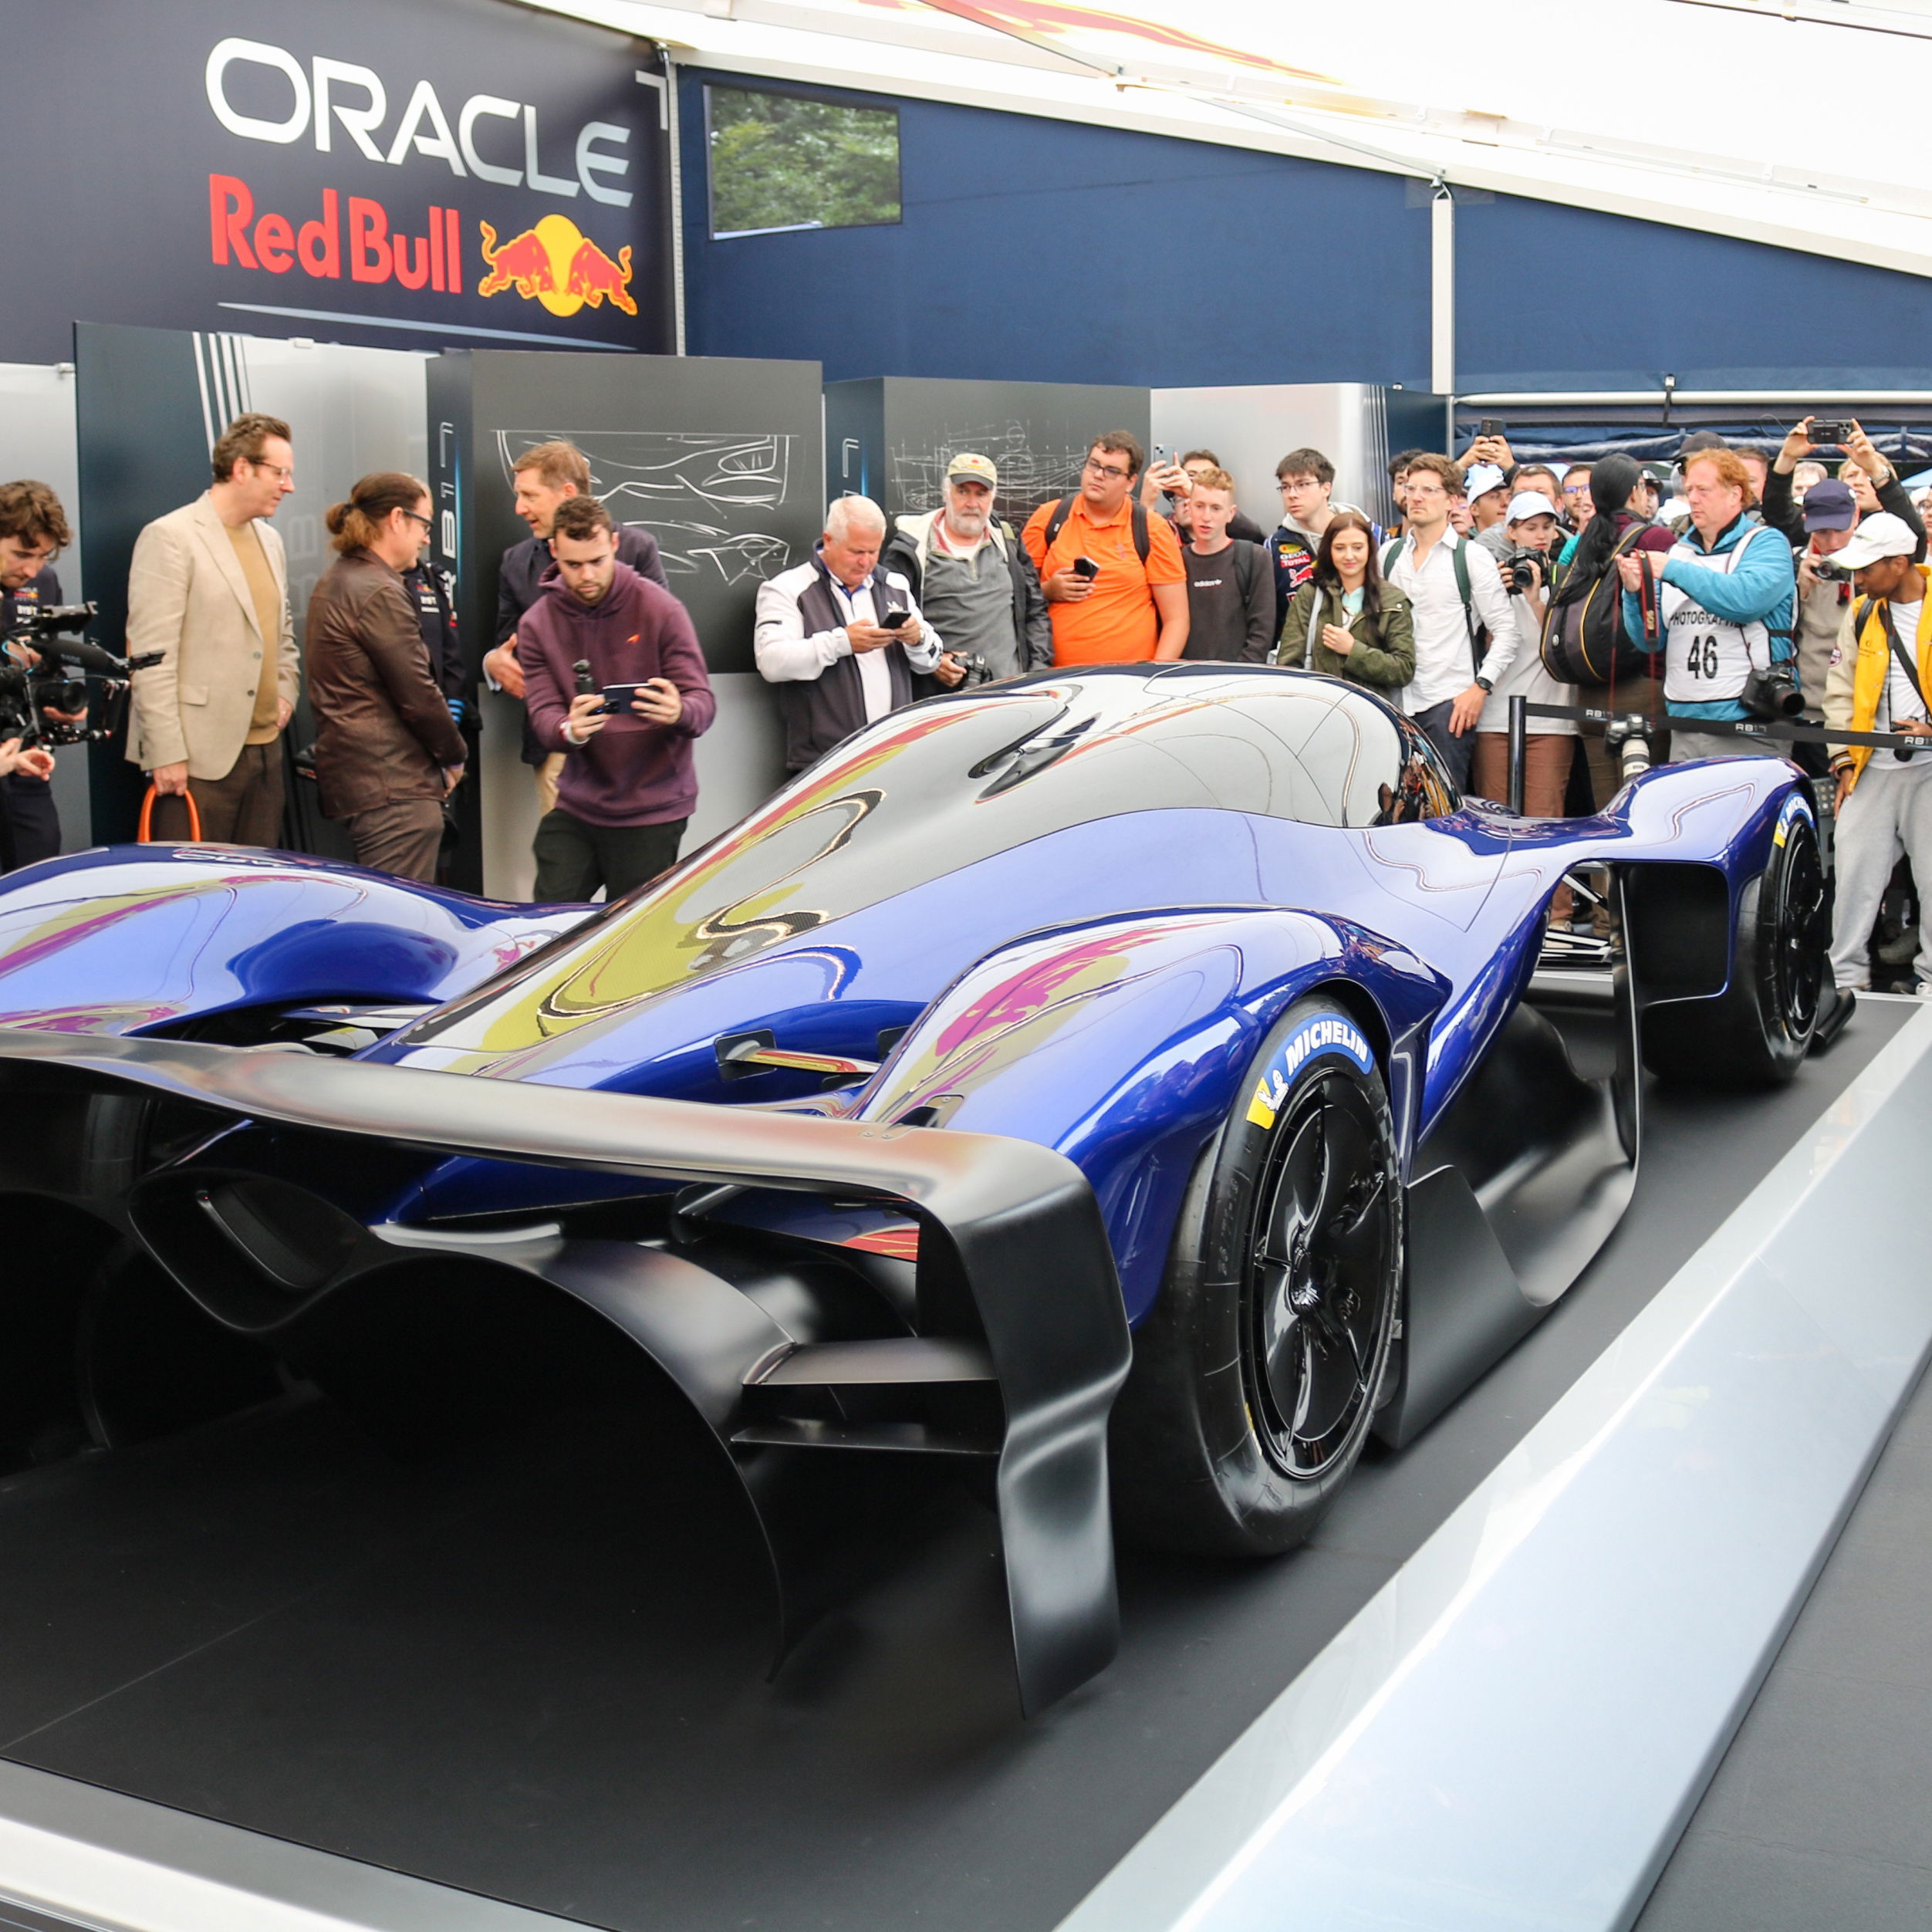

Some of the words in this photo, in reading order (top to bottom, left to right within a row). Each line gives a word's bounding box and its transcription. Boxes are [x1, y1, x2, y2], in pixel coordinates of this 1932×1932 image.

[204, 36, 634, 208] ORACLE
[208, 173, 342, 280] Red
[348, 195, 463, 294] Bull
[1283, 556, 1310, 566] TOTAL
[1687, 635, 1718, 679] 46
[1285, 1020, 1369, 1077] MICHELIN
